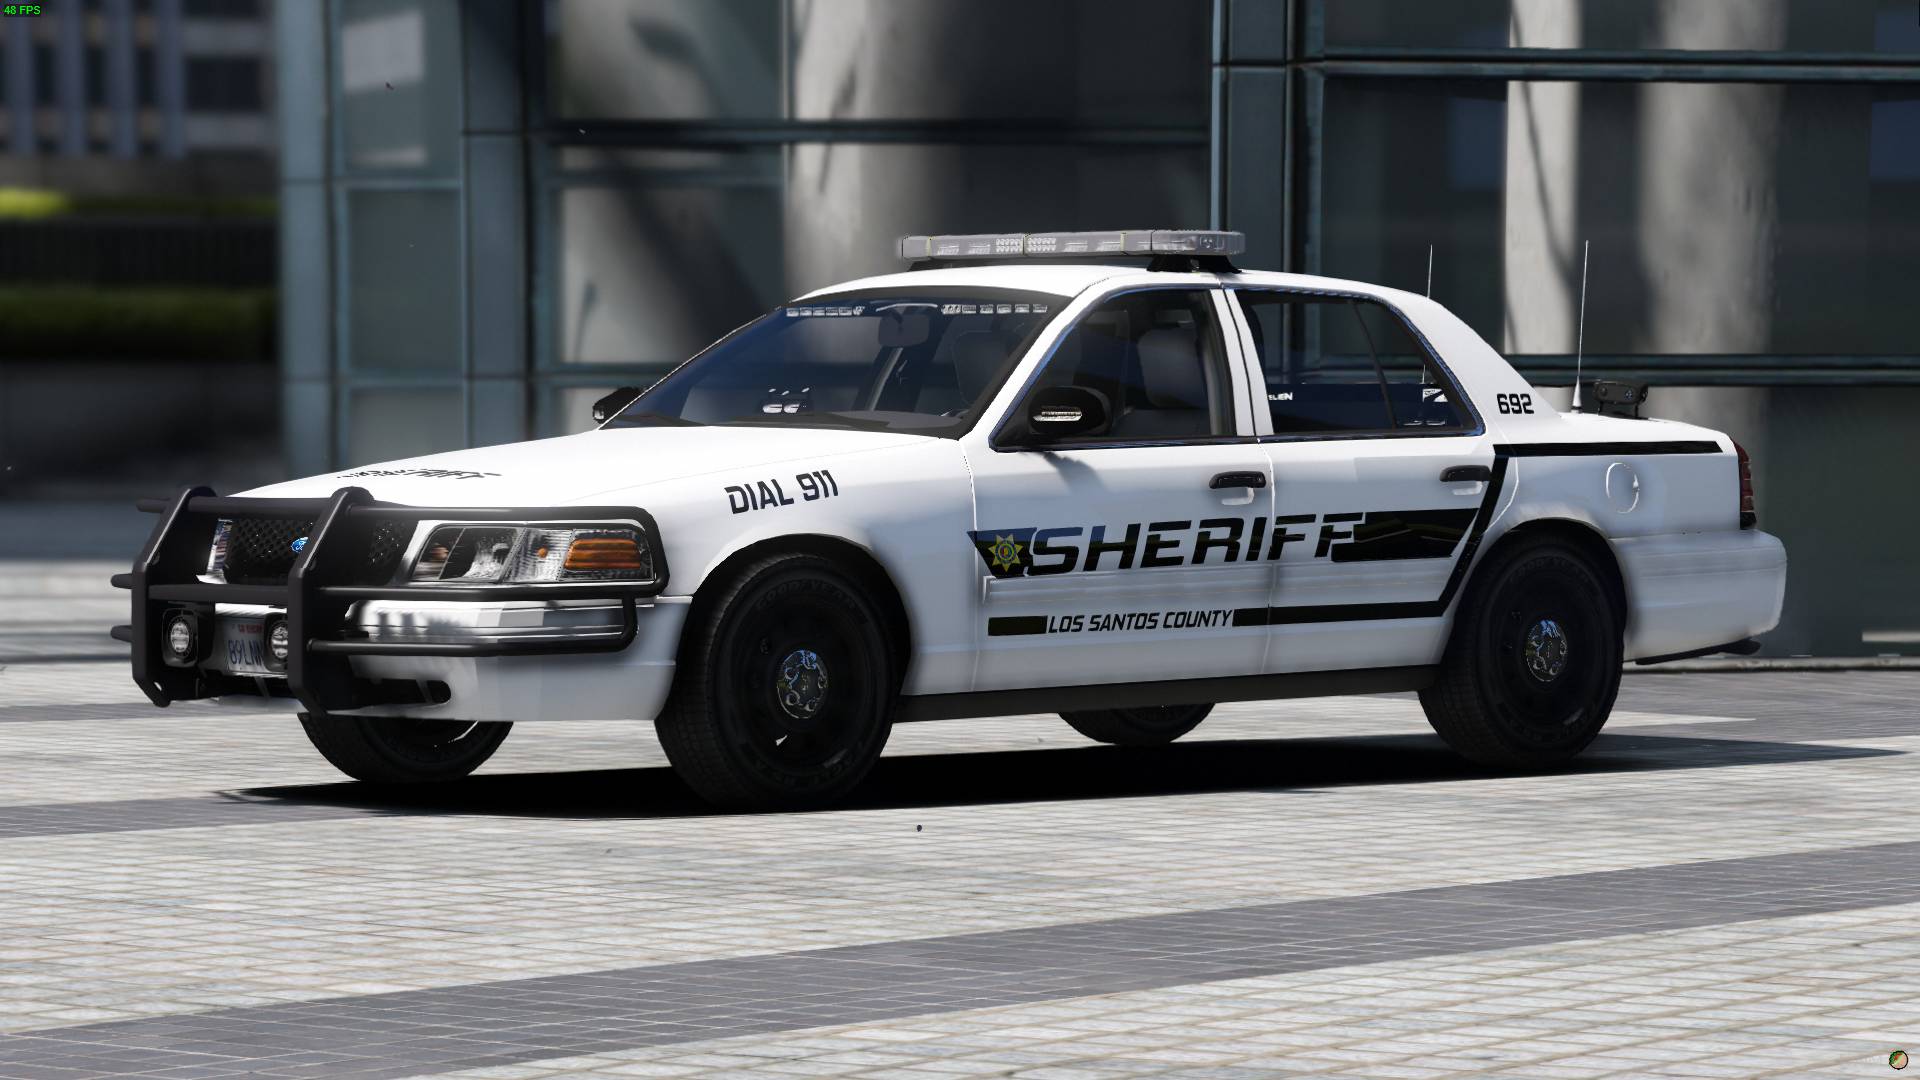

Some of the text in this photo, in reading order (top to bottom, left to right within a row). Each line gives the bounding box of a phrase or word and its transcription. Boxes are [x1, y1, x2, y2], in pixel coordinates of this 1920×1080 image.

[1496, 393, 1534, 415] 692
[724, 469, 838, 514] DIAL 911
[1026, 512, 1364, 576] SHERIFF
[1048, 609, 1232, 633] LOS SANTOS COUNTY
